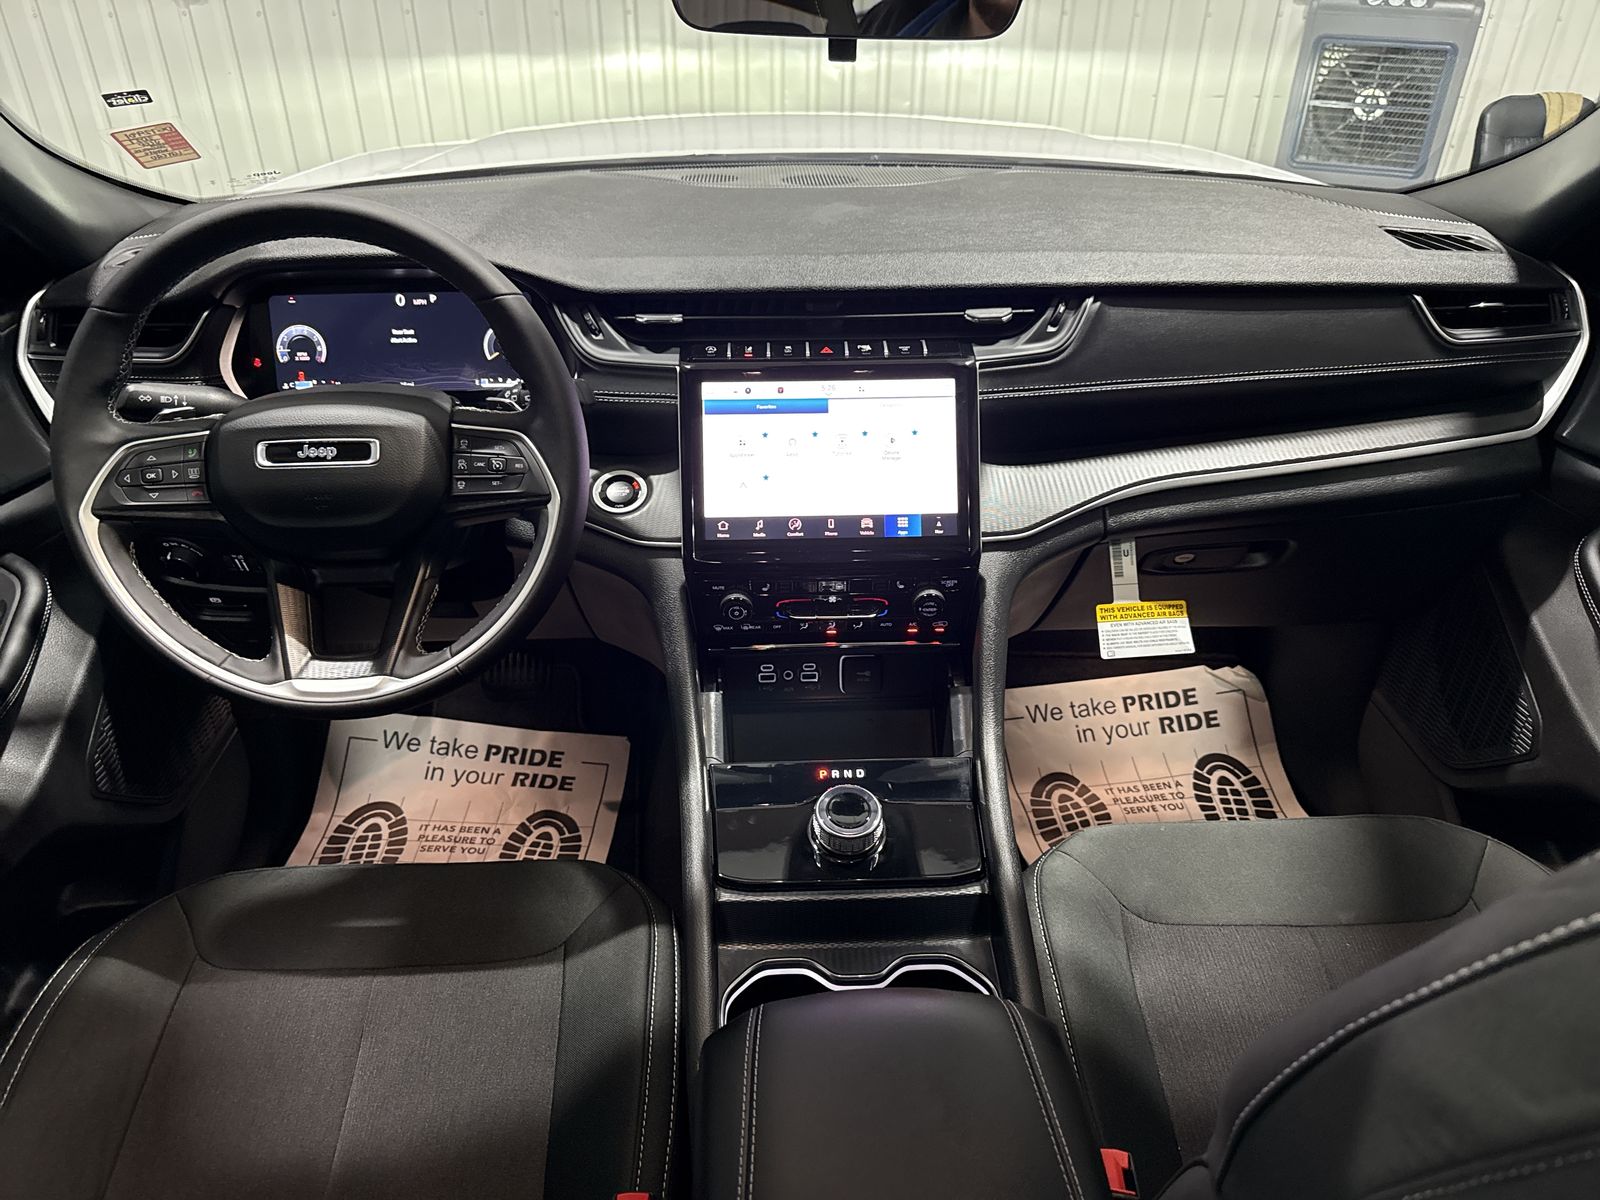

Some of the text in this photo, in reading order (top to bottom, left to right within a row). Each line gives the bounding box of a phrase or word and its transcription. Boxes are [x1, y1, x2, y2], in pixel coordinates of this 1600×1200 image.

[395, 293, 406, 307] 0
[296, 443, 338, 460] Jeep
[145, 472, 157, 480] OK
[1116, 605, 1146, 613] VEHICLE
[1154, 603, 1184, 611] EQUIPPED
[1119, 611, 1155, 619] ADVANCED
[1025, 687, 1199, 723] We take PRIDE
[1075, 709, 1221, 746] in your RIDE
[383, 729, 565, 769] We take PRIDE
[424, 760, 576, 792] in your RIDE
[819, 768, 865, 779] P R N D
[1104, 780, 1184, 796] IT HAS BEEN A
[1112, 791, 1185, 805] PLEASURE TO
[1123, 802, 1185, 815] SERVE YOU
[418, 823, 502, 835] IT HAS BEEN A
[417, 834, 496, 846] PLEASURE TO
[419, 844, 486, 855] SERVE YOU
